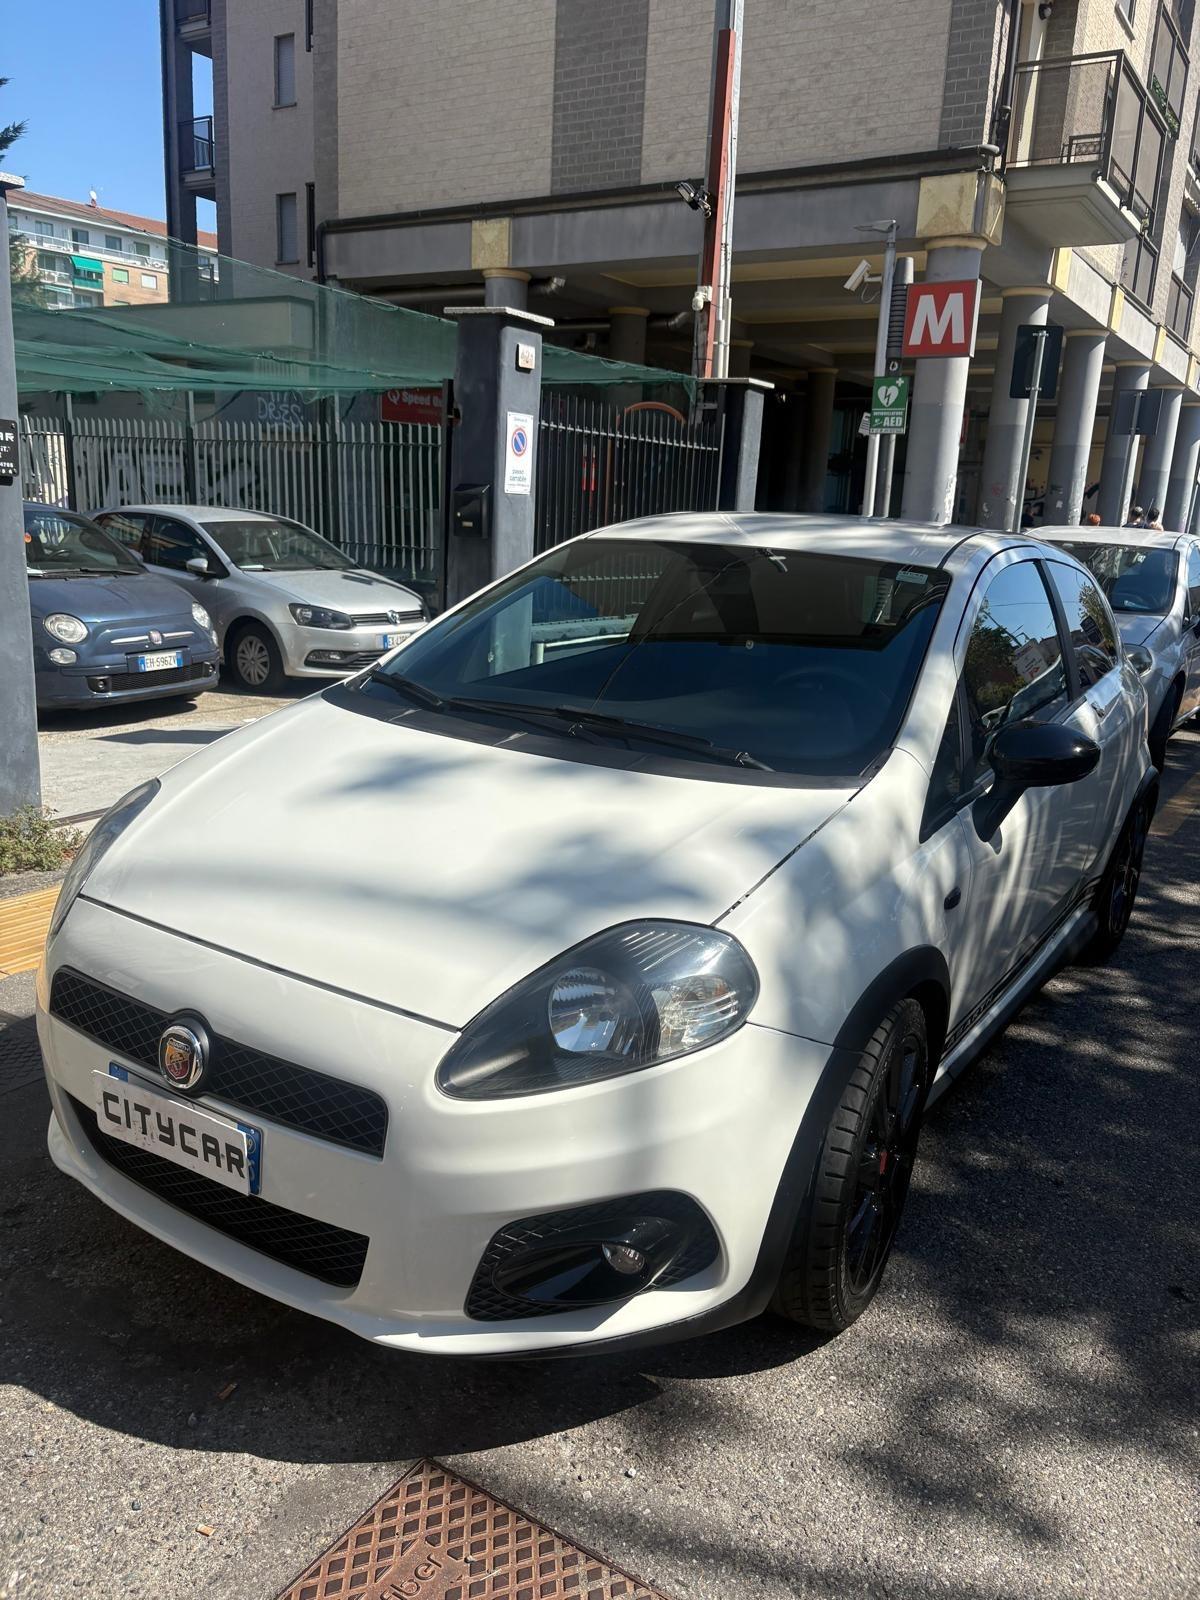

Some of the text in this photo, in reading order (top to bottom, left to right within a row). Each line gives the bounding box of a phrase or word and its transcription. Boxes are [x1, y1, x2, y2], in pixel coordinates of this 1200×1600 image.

[908, 292, 965, 346] M
[882, 416, 903, 428] AED
[103, 1091, 245, 1178] CITYCAR
